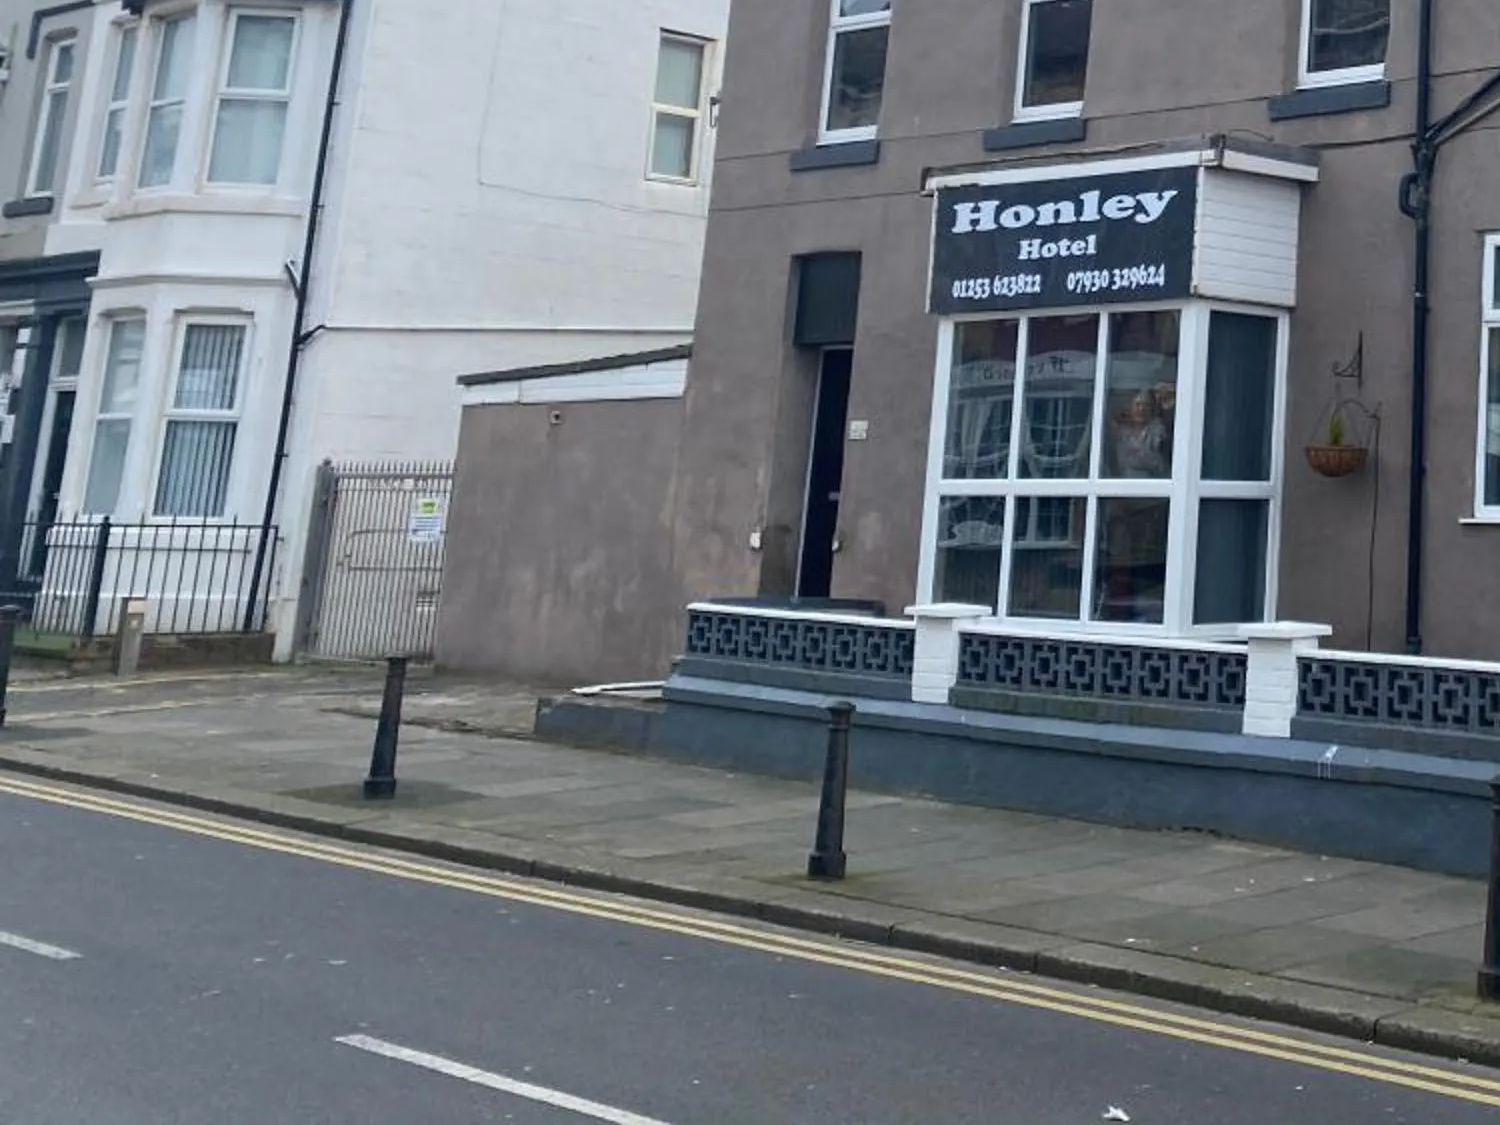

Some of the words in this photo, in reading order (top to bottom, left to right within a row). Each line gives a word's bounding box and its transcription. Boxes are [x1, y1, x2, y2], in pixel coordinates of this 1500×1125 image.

[951, 190, 1178, 233] Honley
[1017, 234, 1096, 260] Hotel
[952, 279, 990, 299] 01253
[993, 273, 1041, 297] 623822
[1067, 269, 1109, 293] 07930
[1112, 264, 1164, 290] 329624
